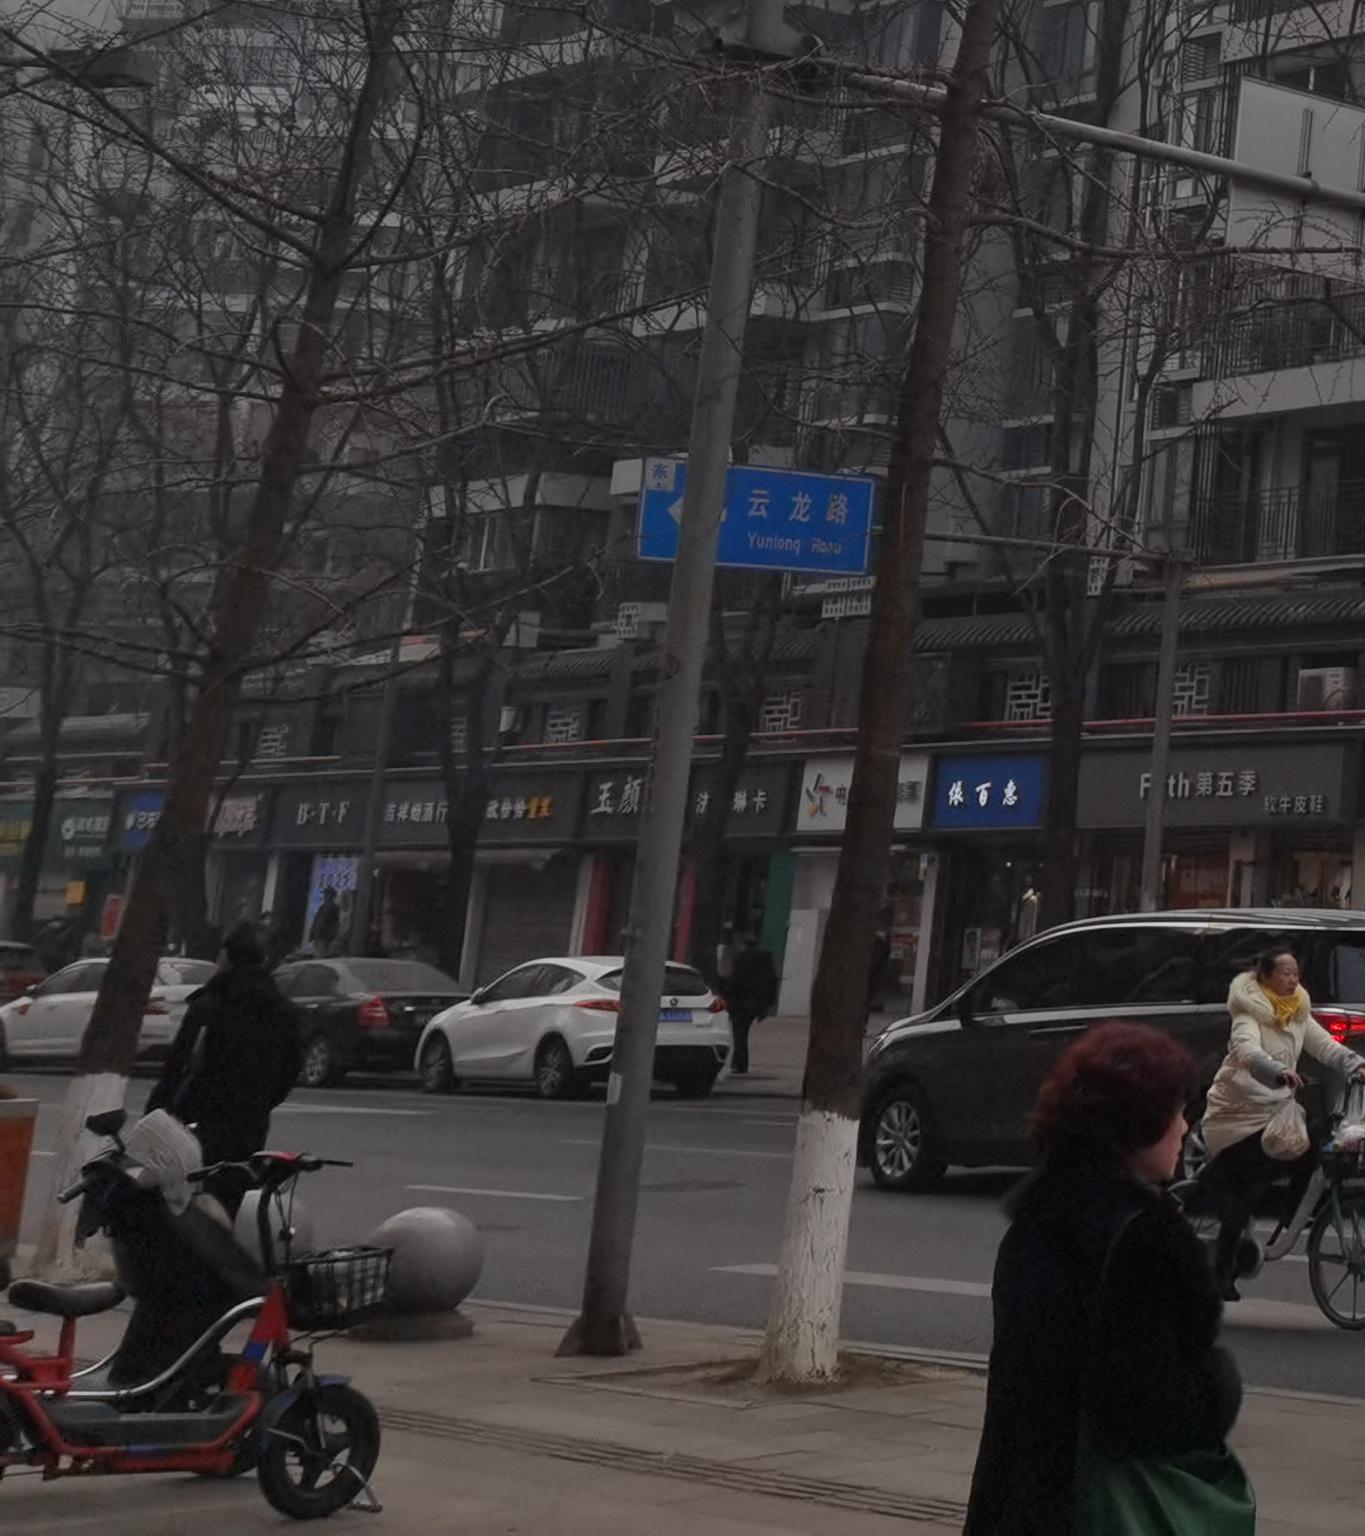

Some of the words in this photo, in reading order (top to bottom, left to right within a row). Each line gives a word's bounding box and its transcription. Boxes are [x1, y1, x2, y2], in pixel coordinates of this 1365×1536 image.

[747, 488, 849, 526] 云龙路
[747, 531, 801, 556] Yunlong
[1139, 771, 1190, 799] Fth
[1196, 769, 1257, 797] 第五季
